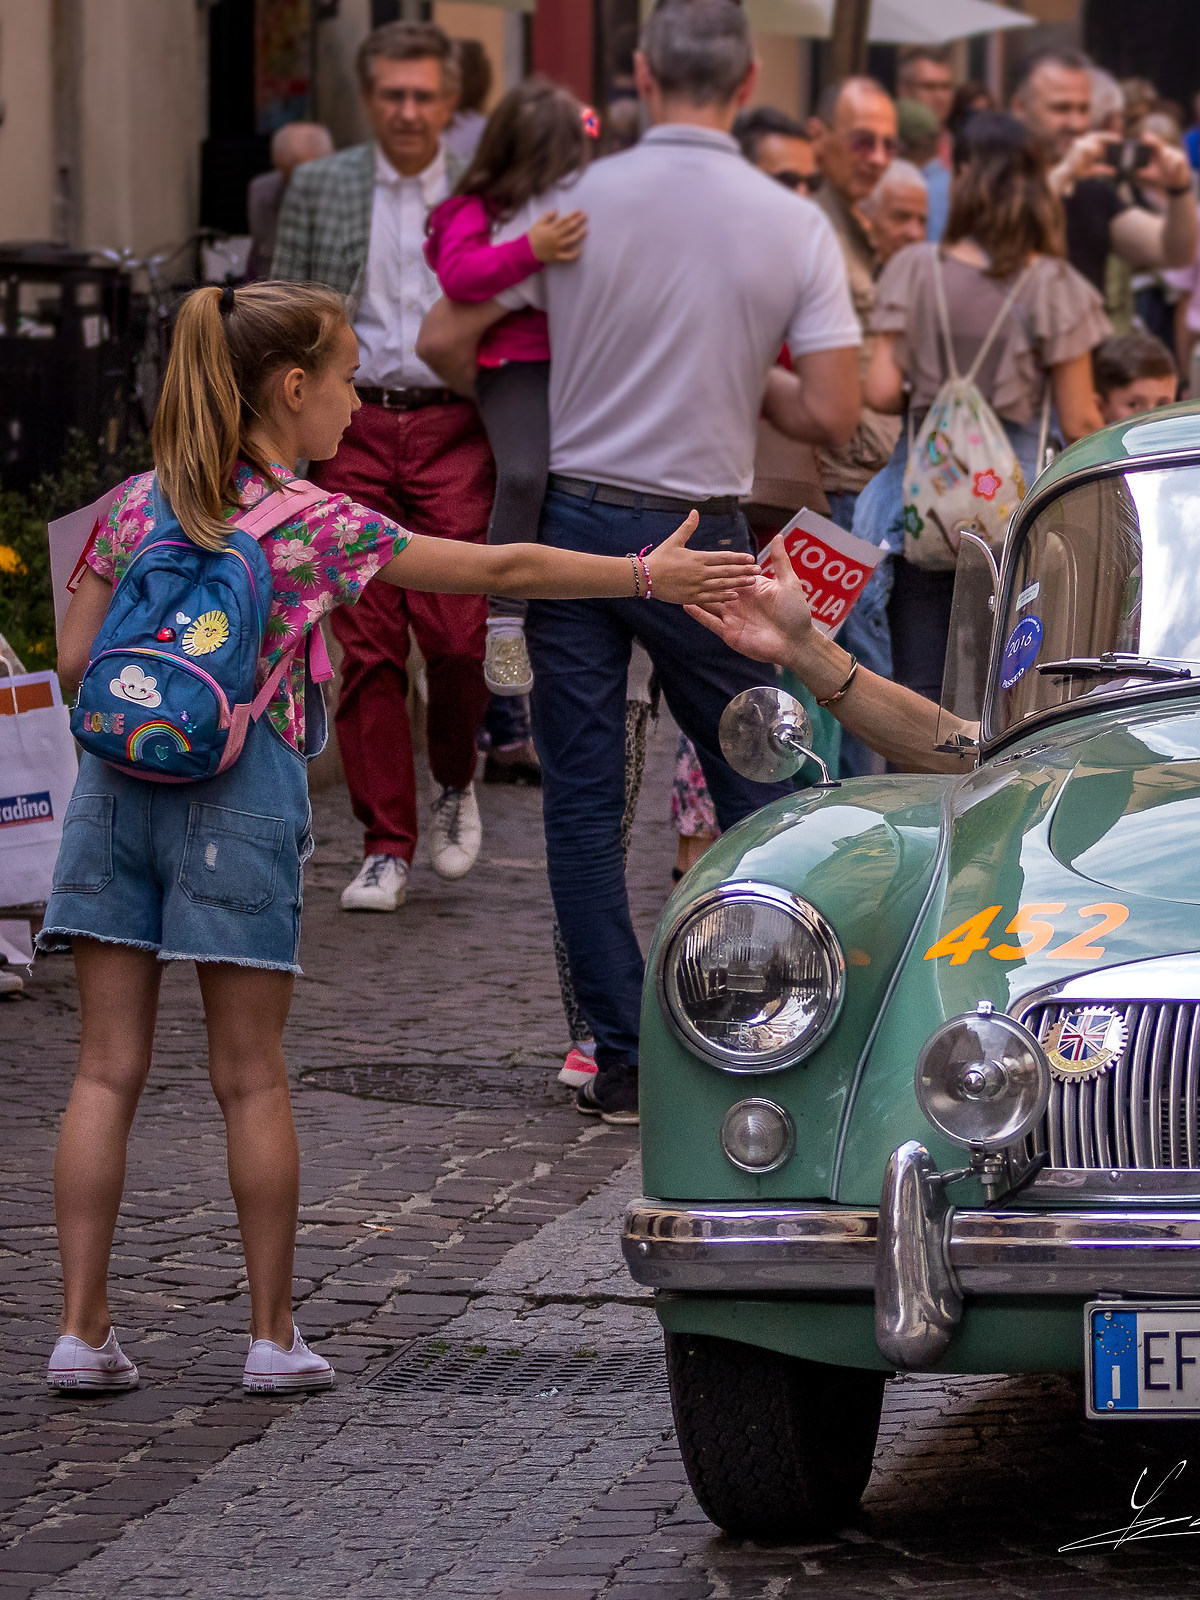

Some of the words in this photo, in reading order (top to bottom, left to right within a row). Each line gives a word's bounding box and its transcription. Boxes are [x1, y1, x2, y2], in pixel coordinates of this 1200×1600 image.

[789, 538, 863, 591] 1000
[1007, 631, 1033, 658] 2016
[83, 711, 125, 735] LOVE
[0, 797, 50, 822] adino
[923, 902, 1130, 966] 452
[1143, 1330, 1200, 1391] EF
[1111, 1364, 1121, 1399] I
